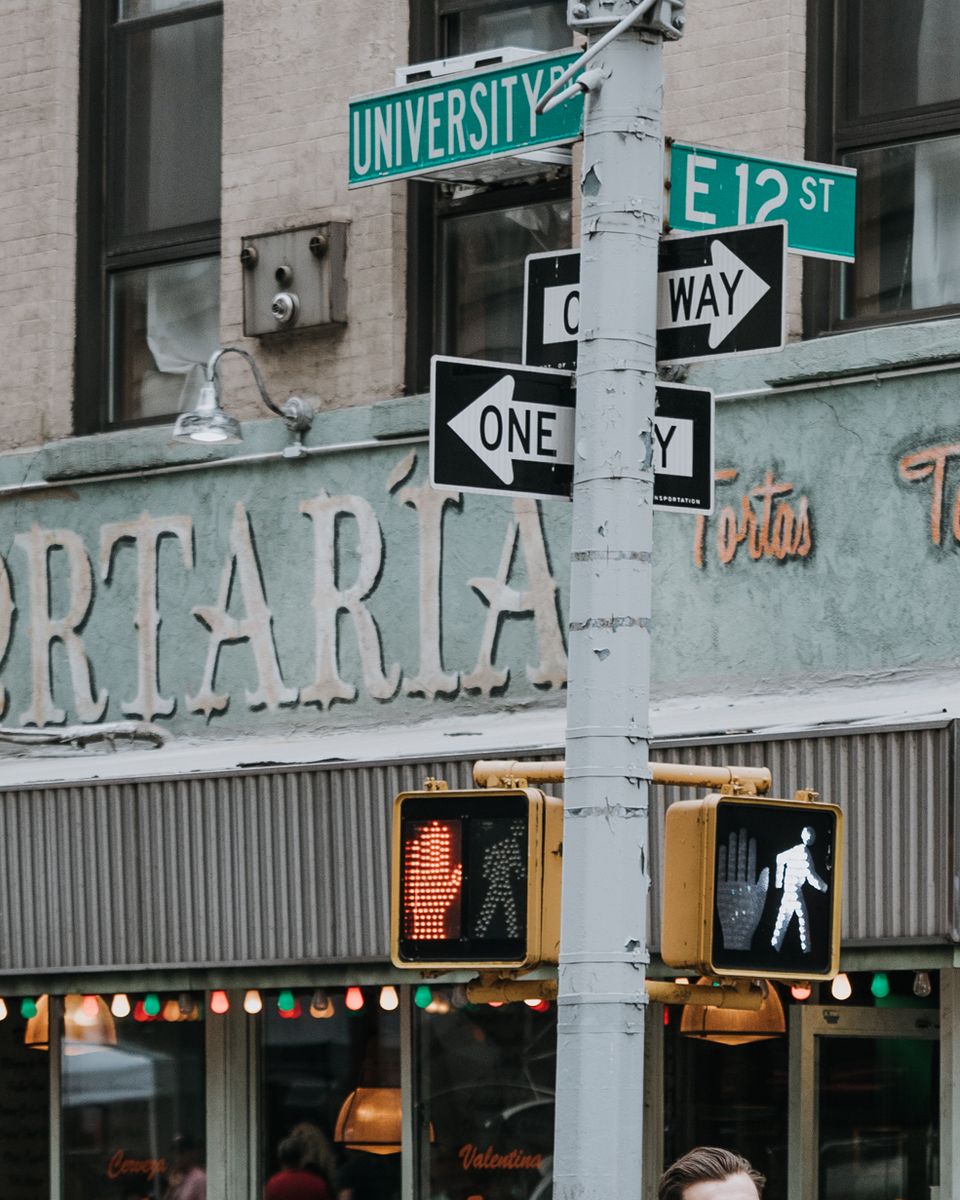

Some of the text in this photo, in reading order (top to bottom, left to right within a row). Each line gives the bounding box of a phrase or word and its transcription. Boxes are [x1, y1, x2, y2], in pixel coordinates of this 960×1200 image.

[353, 69, 545, 176] UNIVERSITY
[685, 154, 835, 226] E 12 ST
[668, 268, 745, 323] WAY
[479, 405, 558, 458] ONE
[693, 470, 813, 567] Tortas
[458, 1143, 543, 1170] Valentina
